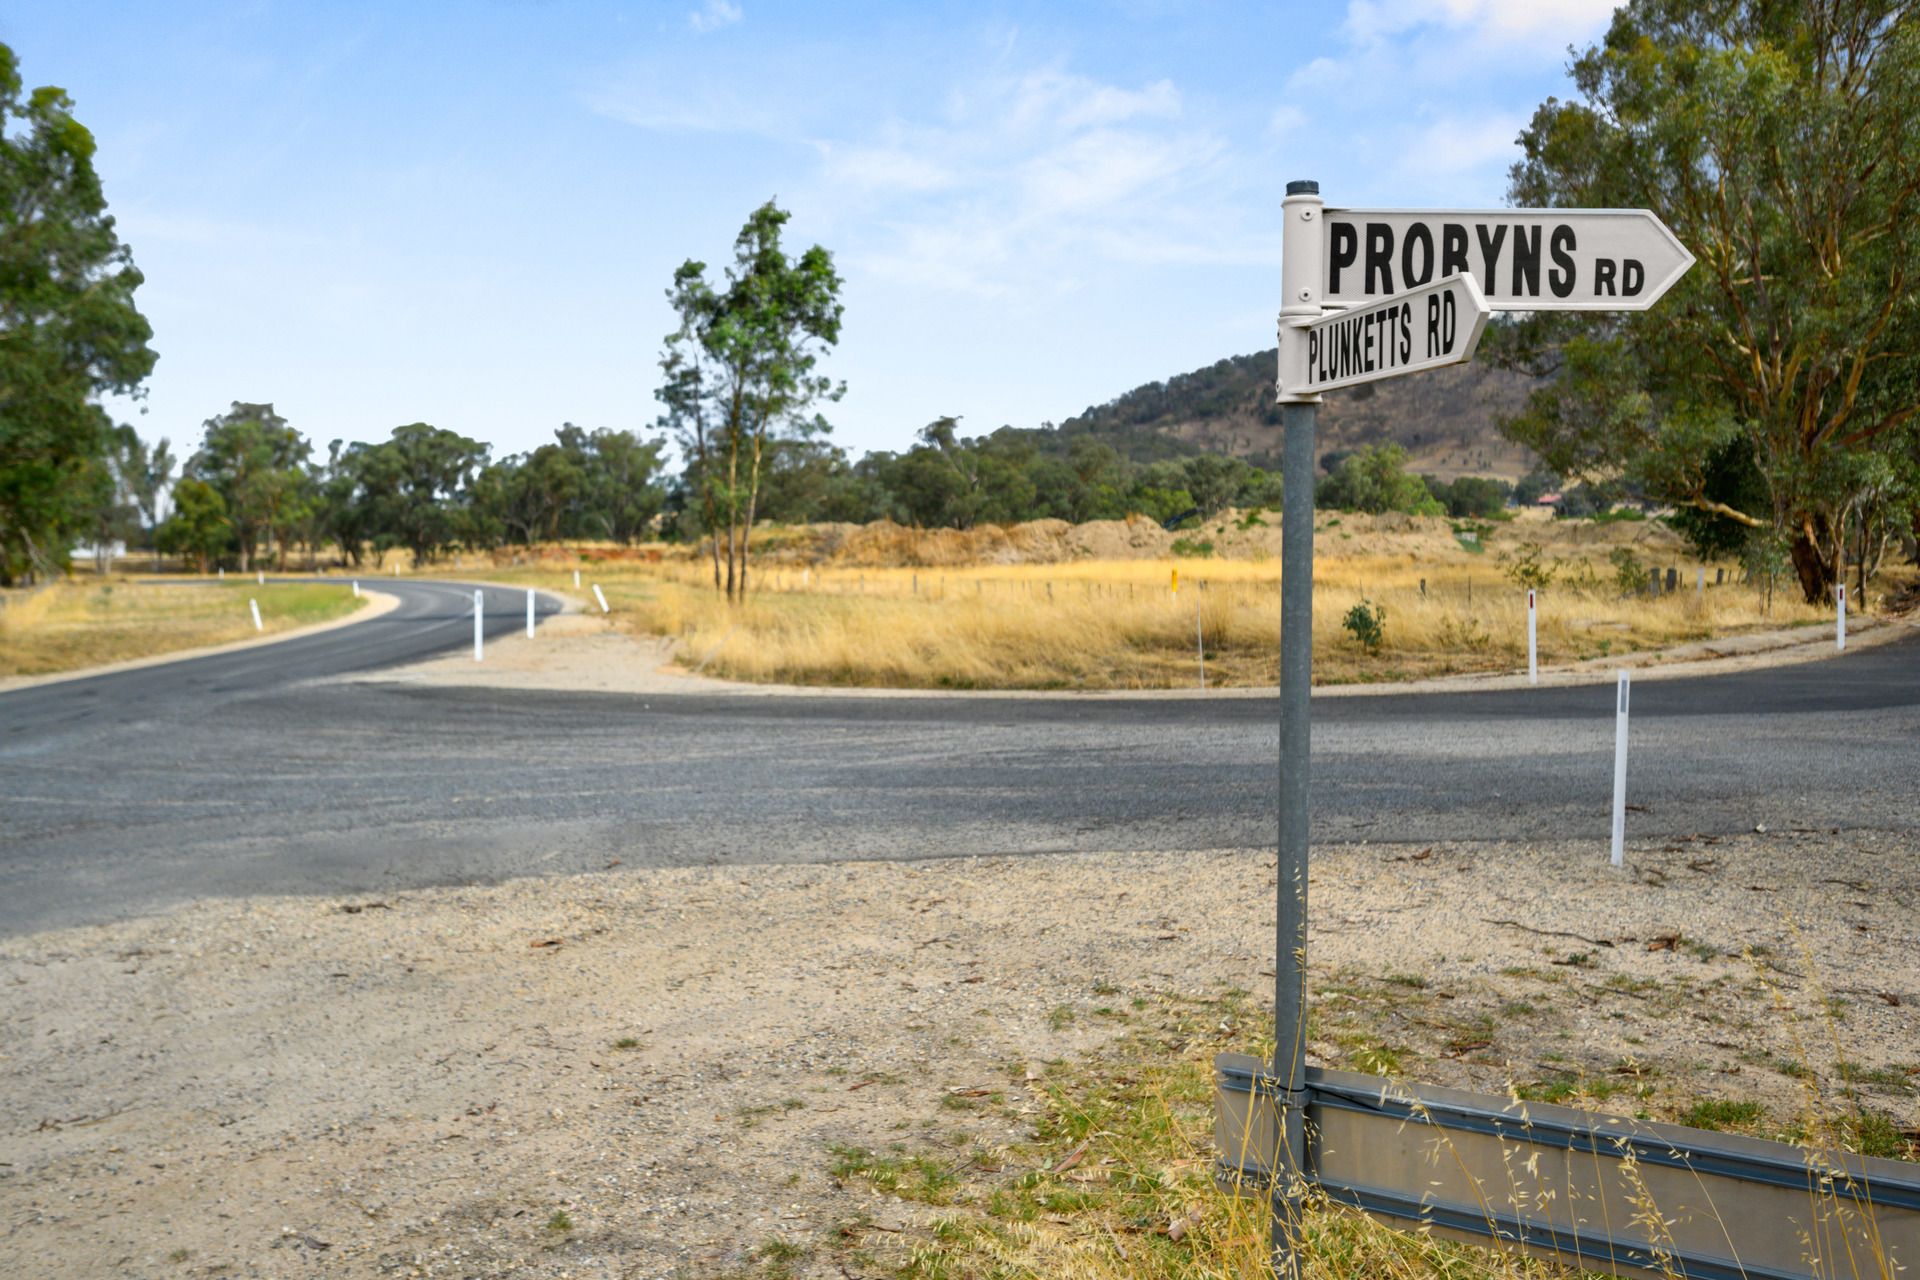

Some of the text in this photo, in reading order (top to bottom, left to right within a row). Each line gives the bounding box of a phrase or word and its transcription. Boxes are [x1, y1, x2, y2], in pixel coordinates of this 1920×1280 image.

[1329, 222, 1645, 298] PROBYNS RD
[1308, 289, 1456, 384] PLUNKETTS RD
